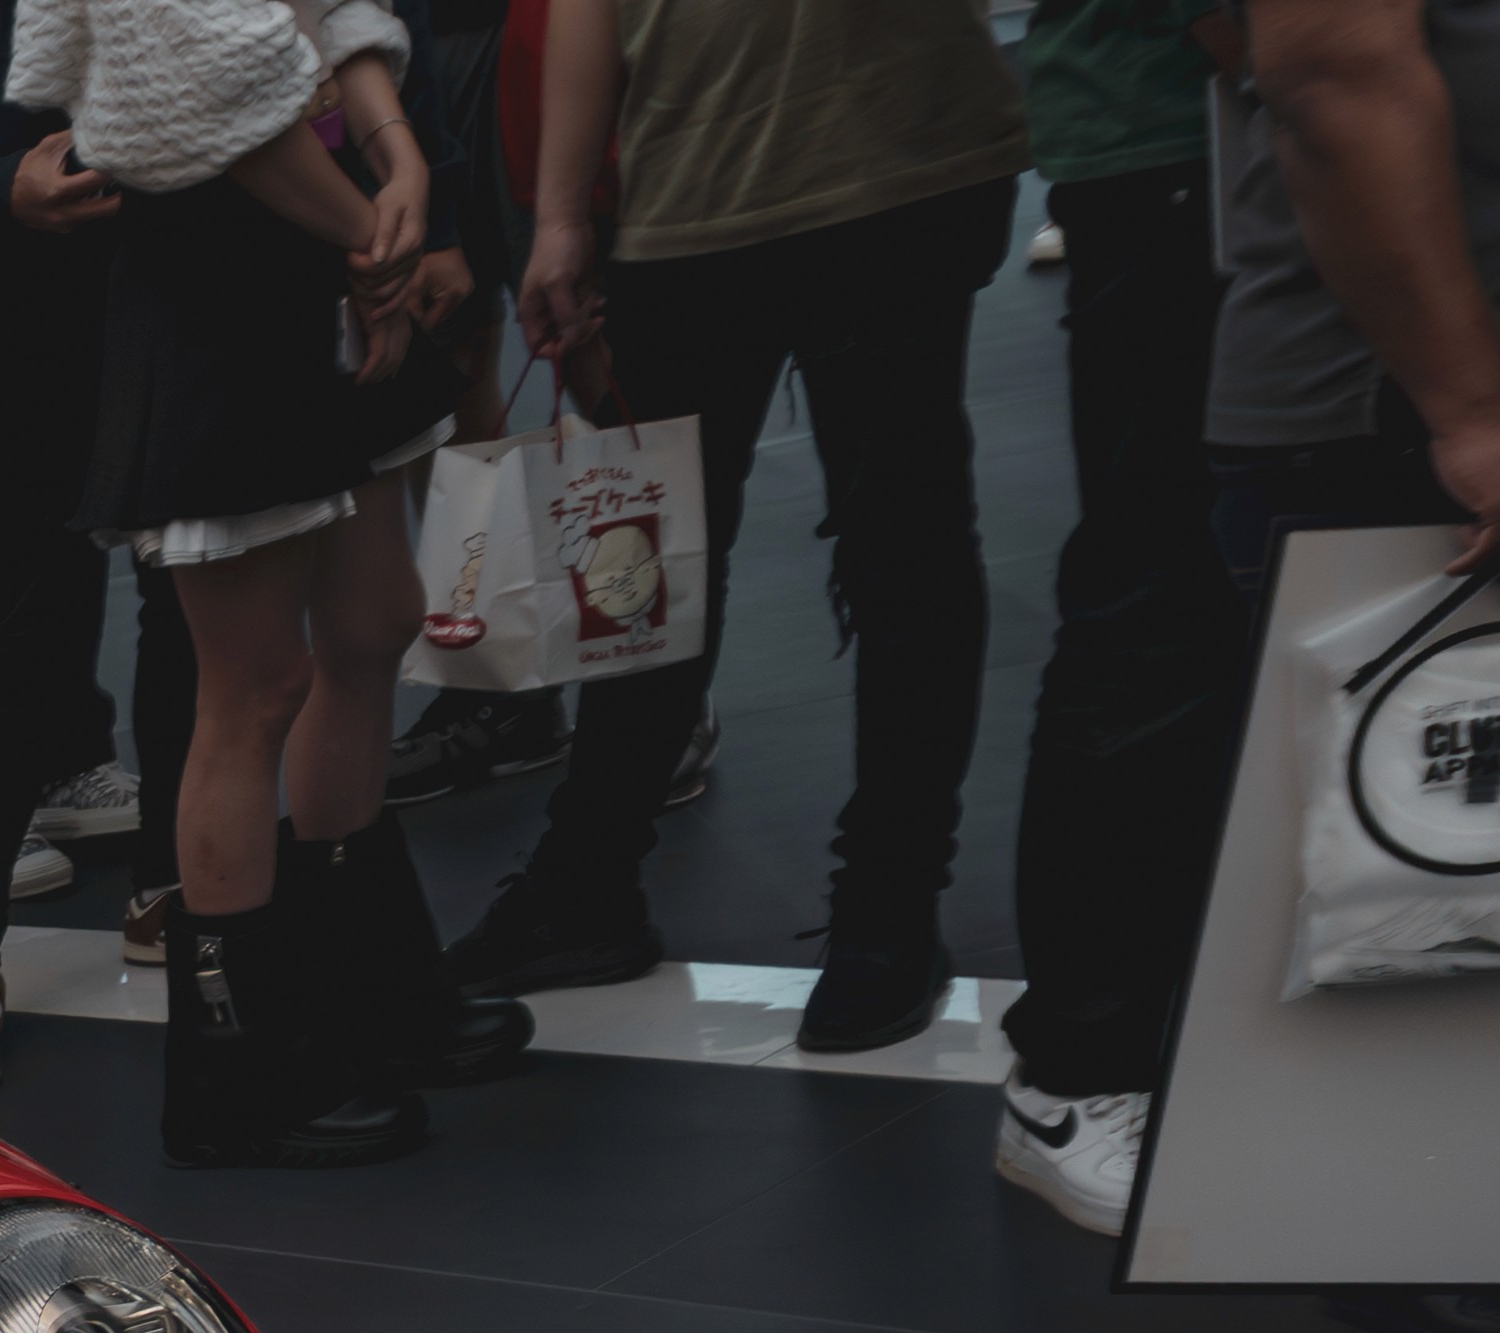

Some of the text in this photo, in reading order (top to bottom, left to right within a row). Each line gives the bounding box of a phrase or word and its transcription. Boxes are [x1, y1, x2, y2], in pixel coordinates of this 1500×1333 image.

[550, 481, 666, 525] チーズケーキ
